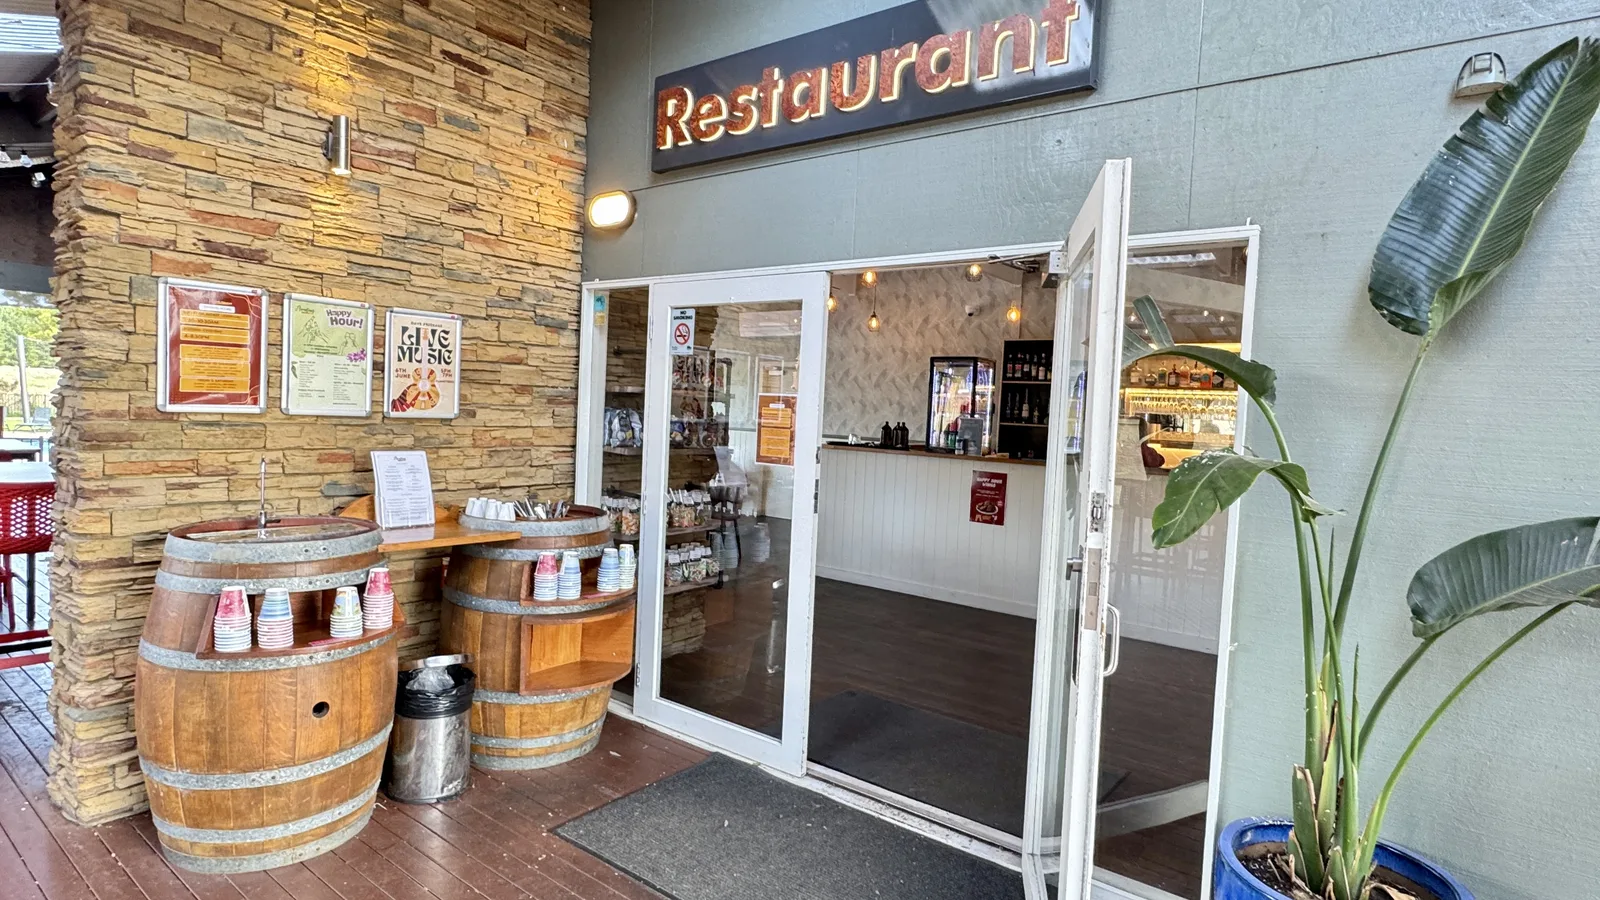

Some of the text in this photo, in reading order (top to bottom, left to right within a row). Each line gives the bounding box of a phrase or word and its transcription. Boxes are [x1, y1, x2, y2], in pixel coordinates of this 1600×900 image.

[656, 0, 1080, 150] Restaurant
[401, 326, 450, 349] LIVE
[397, 345, 453, 365] MUSIC
